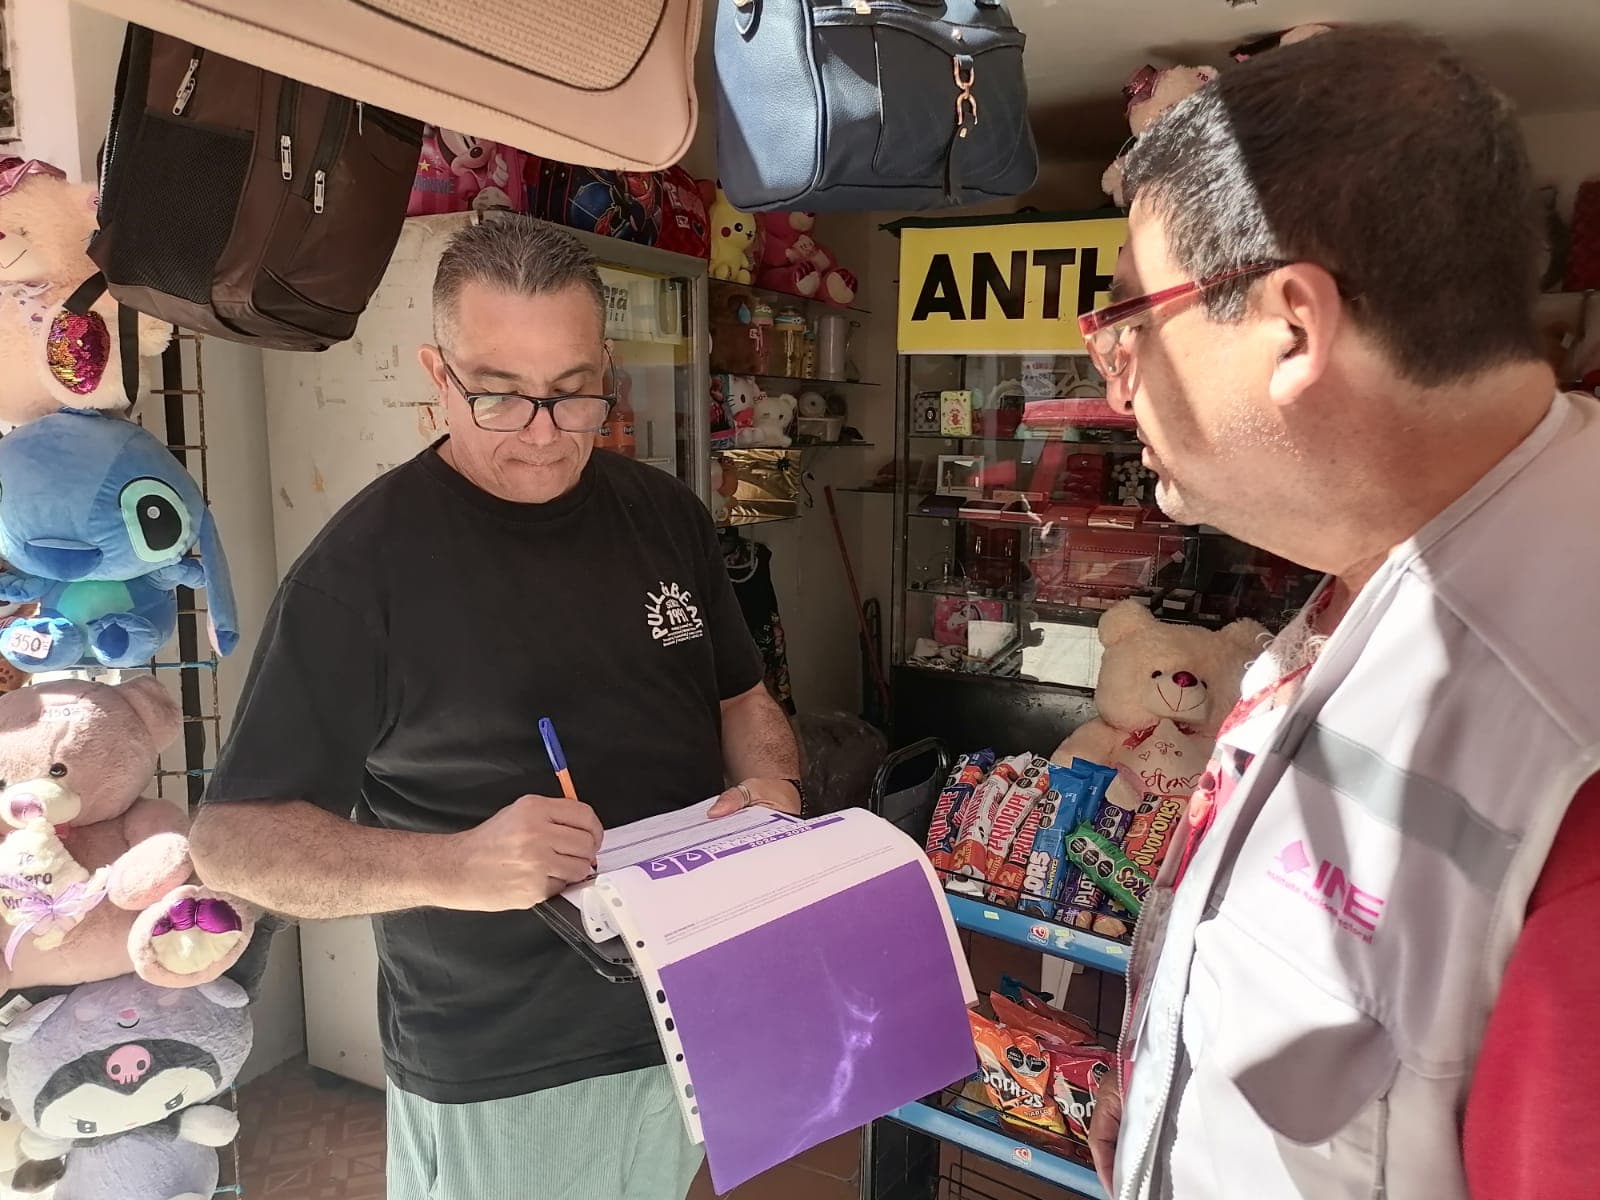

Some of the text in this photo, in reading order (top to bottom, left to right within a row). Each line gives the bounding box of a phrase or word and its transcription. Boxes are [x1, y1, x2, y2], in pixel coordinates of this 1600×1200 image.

[644, 591, 668, 640] PULL
[988, 791, 1032, 853] PRINCIPE
[1313, 859, 1385, 931] INE
